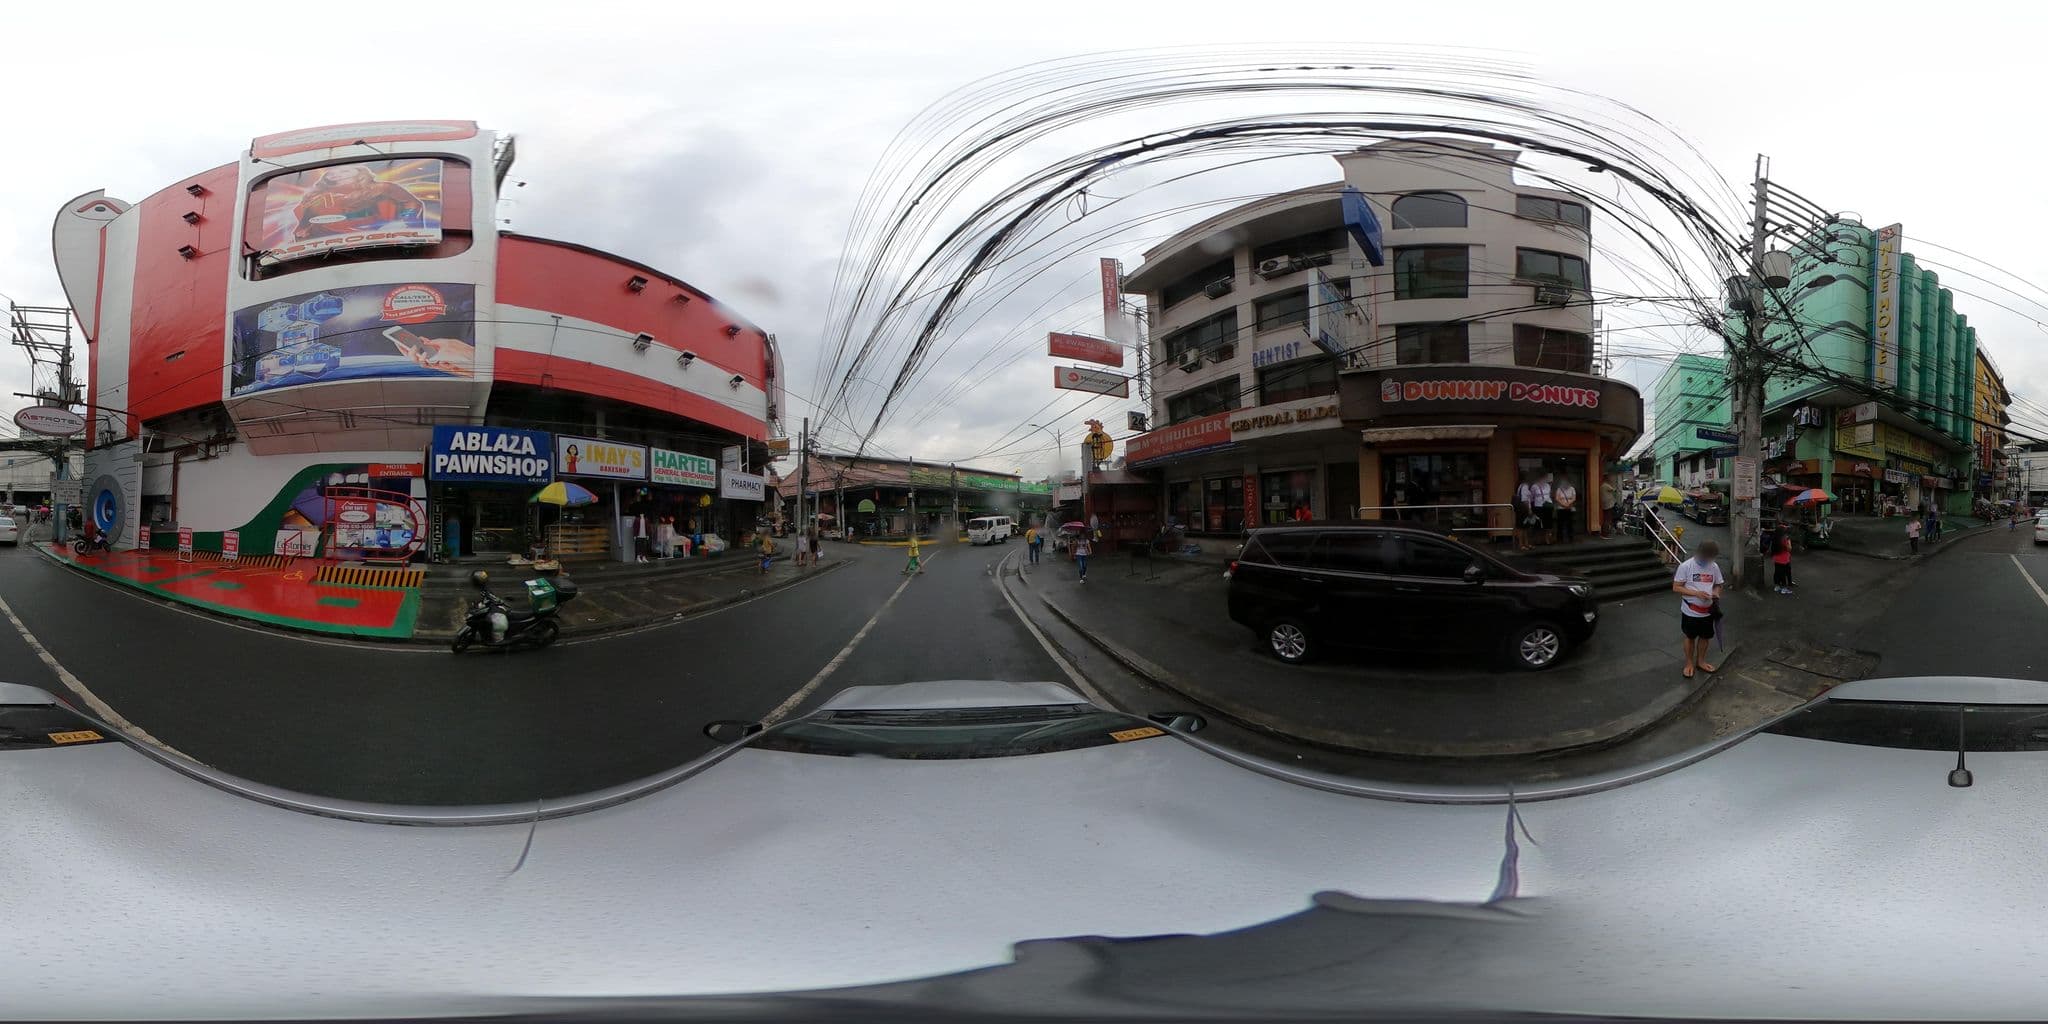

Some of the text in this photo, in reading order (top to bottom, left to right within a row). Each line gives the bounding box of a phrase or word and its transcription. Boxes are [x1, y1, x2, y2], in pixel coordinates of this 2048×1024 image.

[272, 231, 434, 255] ASTROGIRL
[1879, 241, 1893, 294] NICE
[1877, 298, 1891, 384] HOTEL
[1252, 341, 1300, 368] DENTIST
[1404, 379, 1599, 408] DUNKIN' DONUTS
[19, 411, 82, 426] ASTROTEL
[1131, 415, 1145, 427] 24
[1231, 411, 1294, 433] CENTRAL
[450, 431, 536, 455] ABLAZA
[1160, 419, 1223, 444] LHUILLIER
[435, 454, 549, 477] PAWNSHOP
[586, 443, 642, 468] INAY'S
[654, 450, 714, 475] HARTEL
[599, 465, 630, 474] BAKESHOP
[654, 467, 680, 477] GENERAL
[681, 470, 715, 482] MERCHANDISE
[731, 478, 761, 492] PHARMACY
